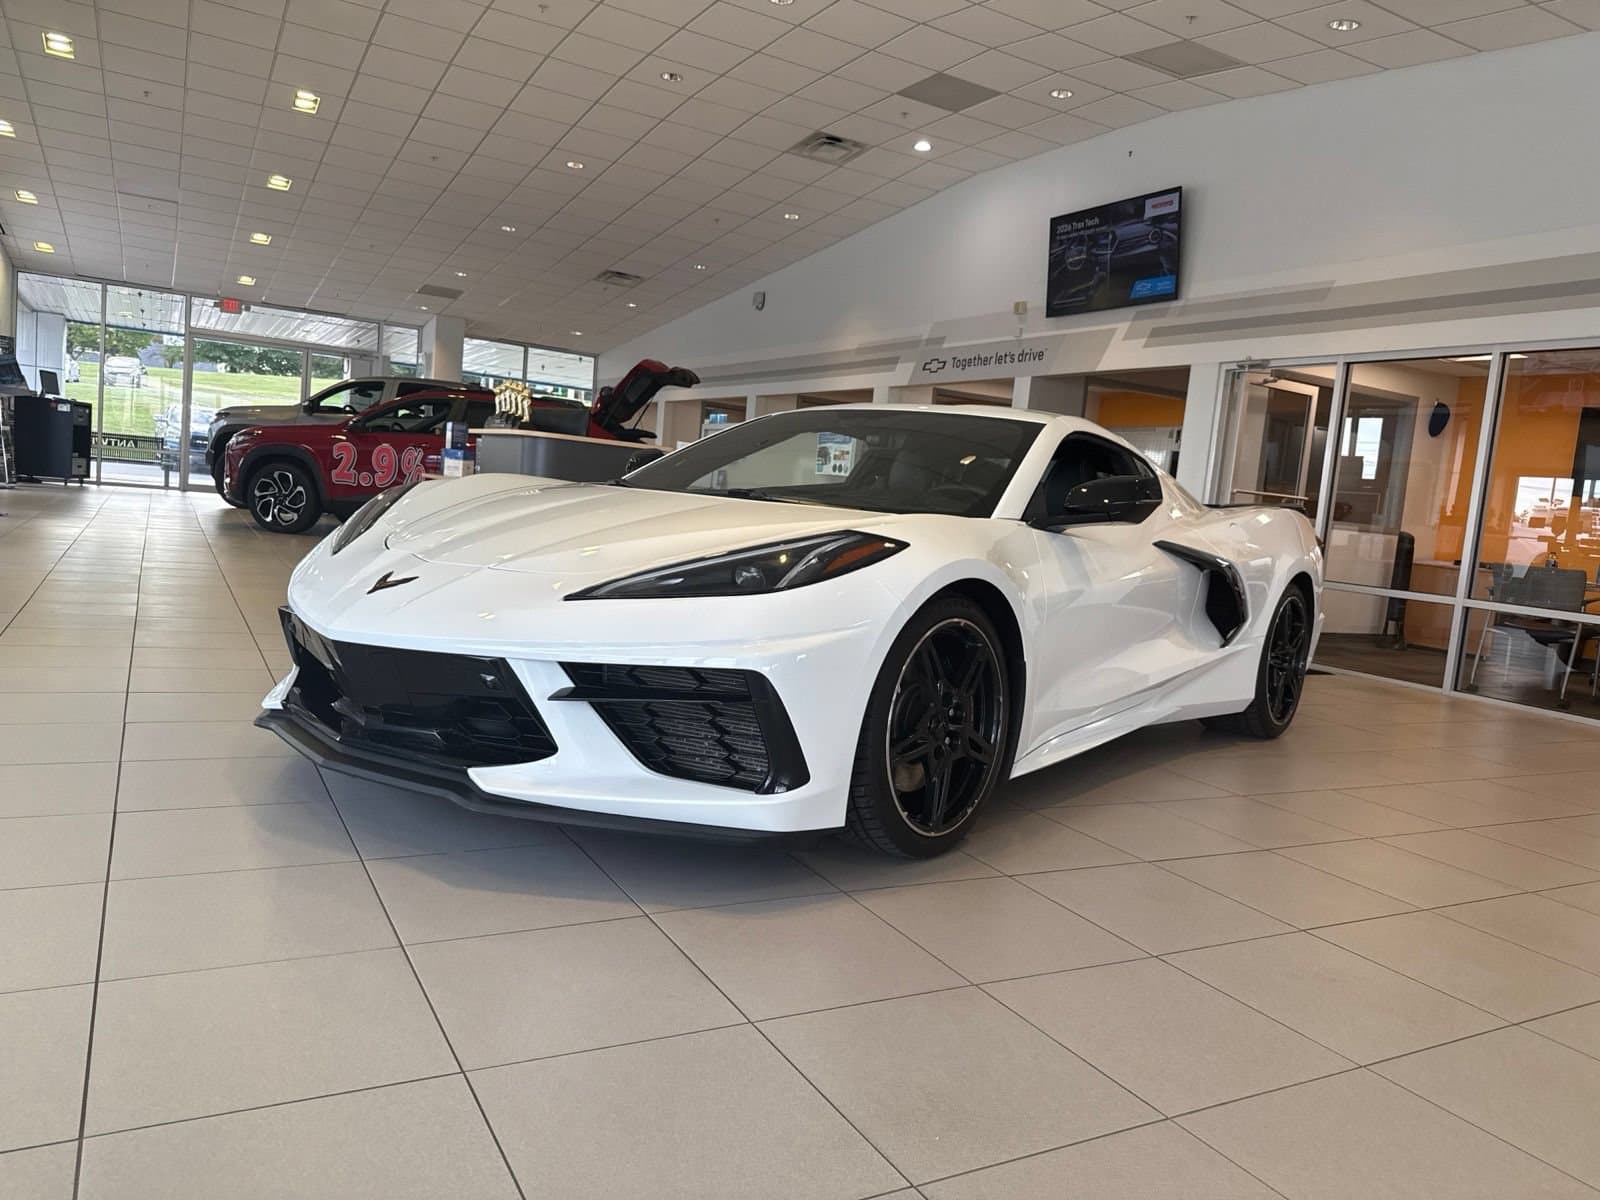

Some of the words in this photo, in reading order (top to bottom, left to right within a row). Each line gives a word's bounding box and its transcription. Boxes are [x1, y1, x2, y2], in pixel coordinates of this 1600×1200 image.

[951, 353, 994, 371] Together
[994, 351, 1015, 365] let's
[1017, 348, 1045, 363] drive
[332, 442, 425, 487] 2.9%
